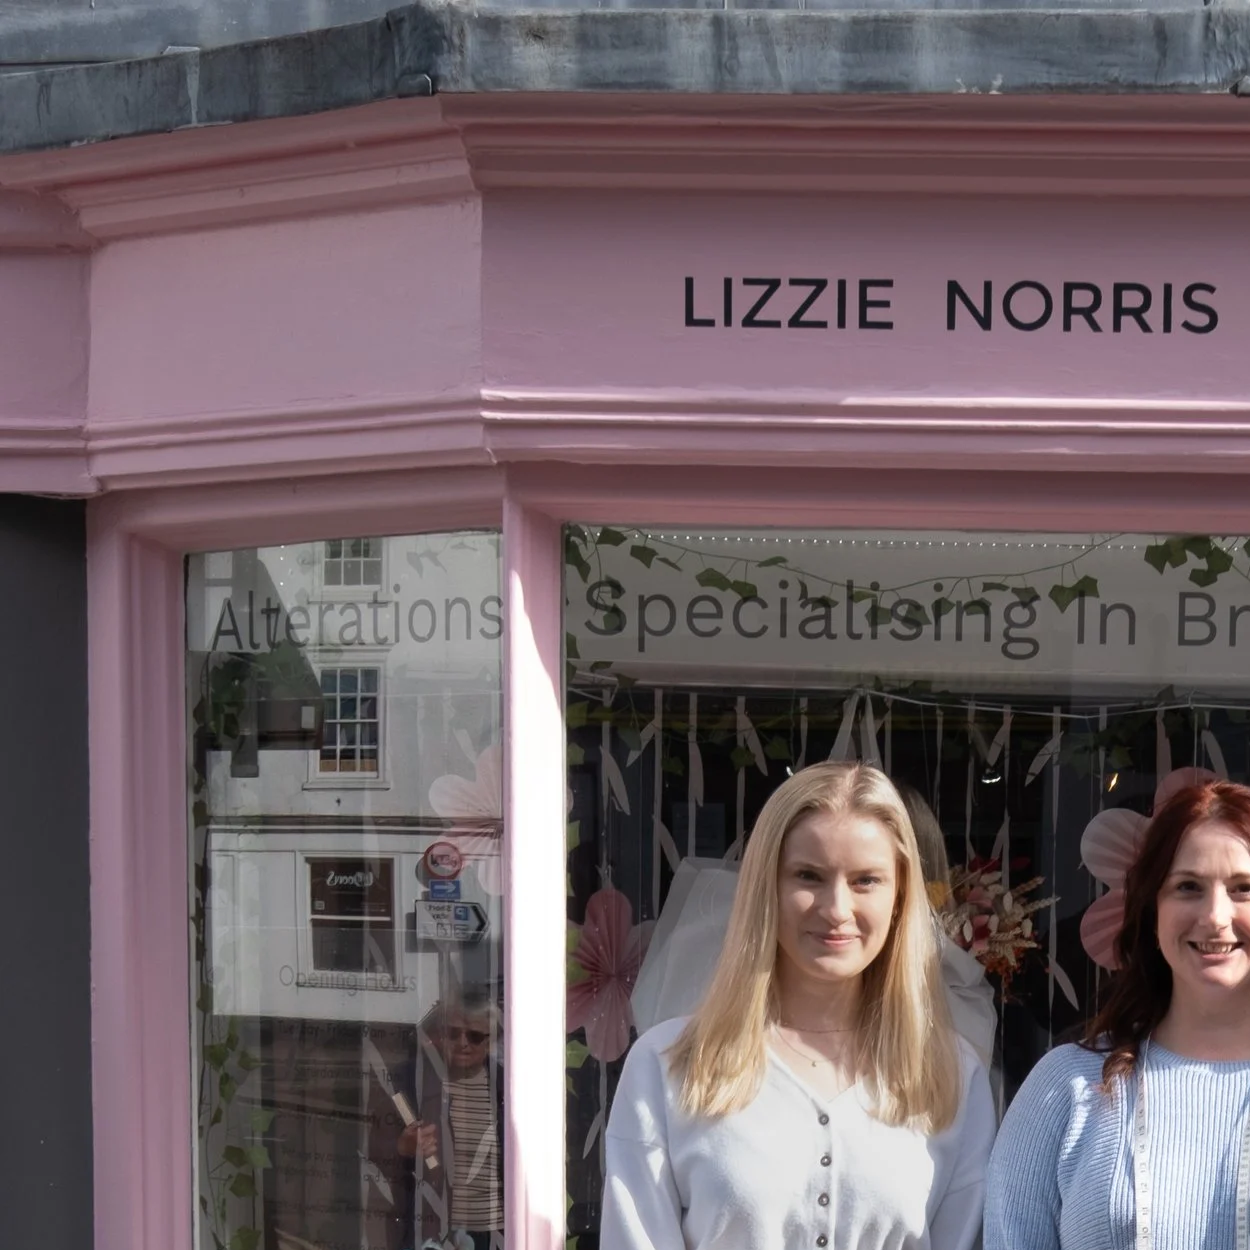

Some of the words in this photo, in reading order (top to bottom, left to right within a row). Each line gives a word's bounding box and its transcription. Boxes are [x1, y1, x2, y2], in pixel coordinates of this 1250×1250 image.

[684, 276, 894, 330] LIZZIE
[945, 279, 1219, 335] NORRIS
[212, 583, 504, 651] Alterations
[583, 579, 1041, 661] Specialising
[1076, 589, 1137, 646] In
[1142, 1226, 1149, 1239] 10
